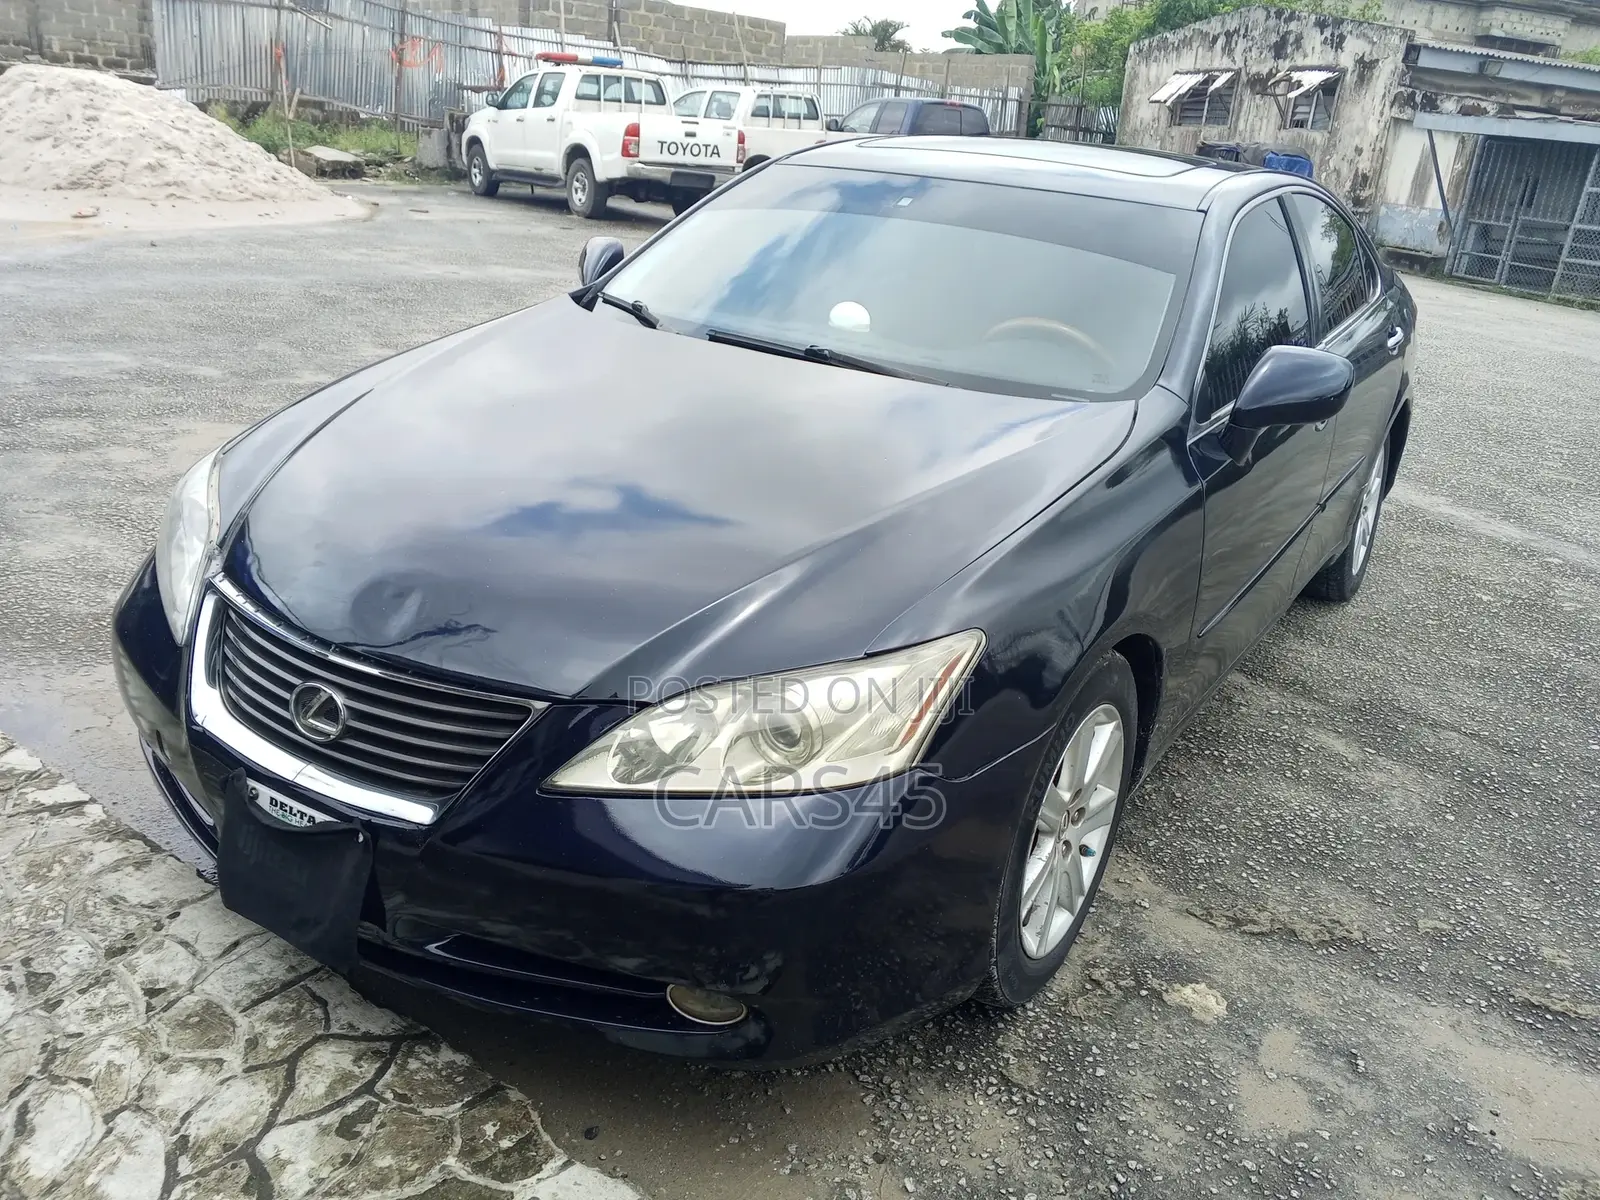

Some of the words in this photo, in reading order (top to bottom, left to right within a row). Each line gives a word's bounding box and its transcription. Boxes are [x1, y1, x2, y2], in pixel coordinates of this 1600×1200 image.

[657, 140, 721, 158] TOYOTA
[268, 805, 280, 817] THE
[269, 796, 316, 825] DELTA
